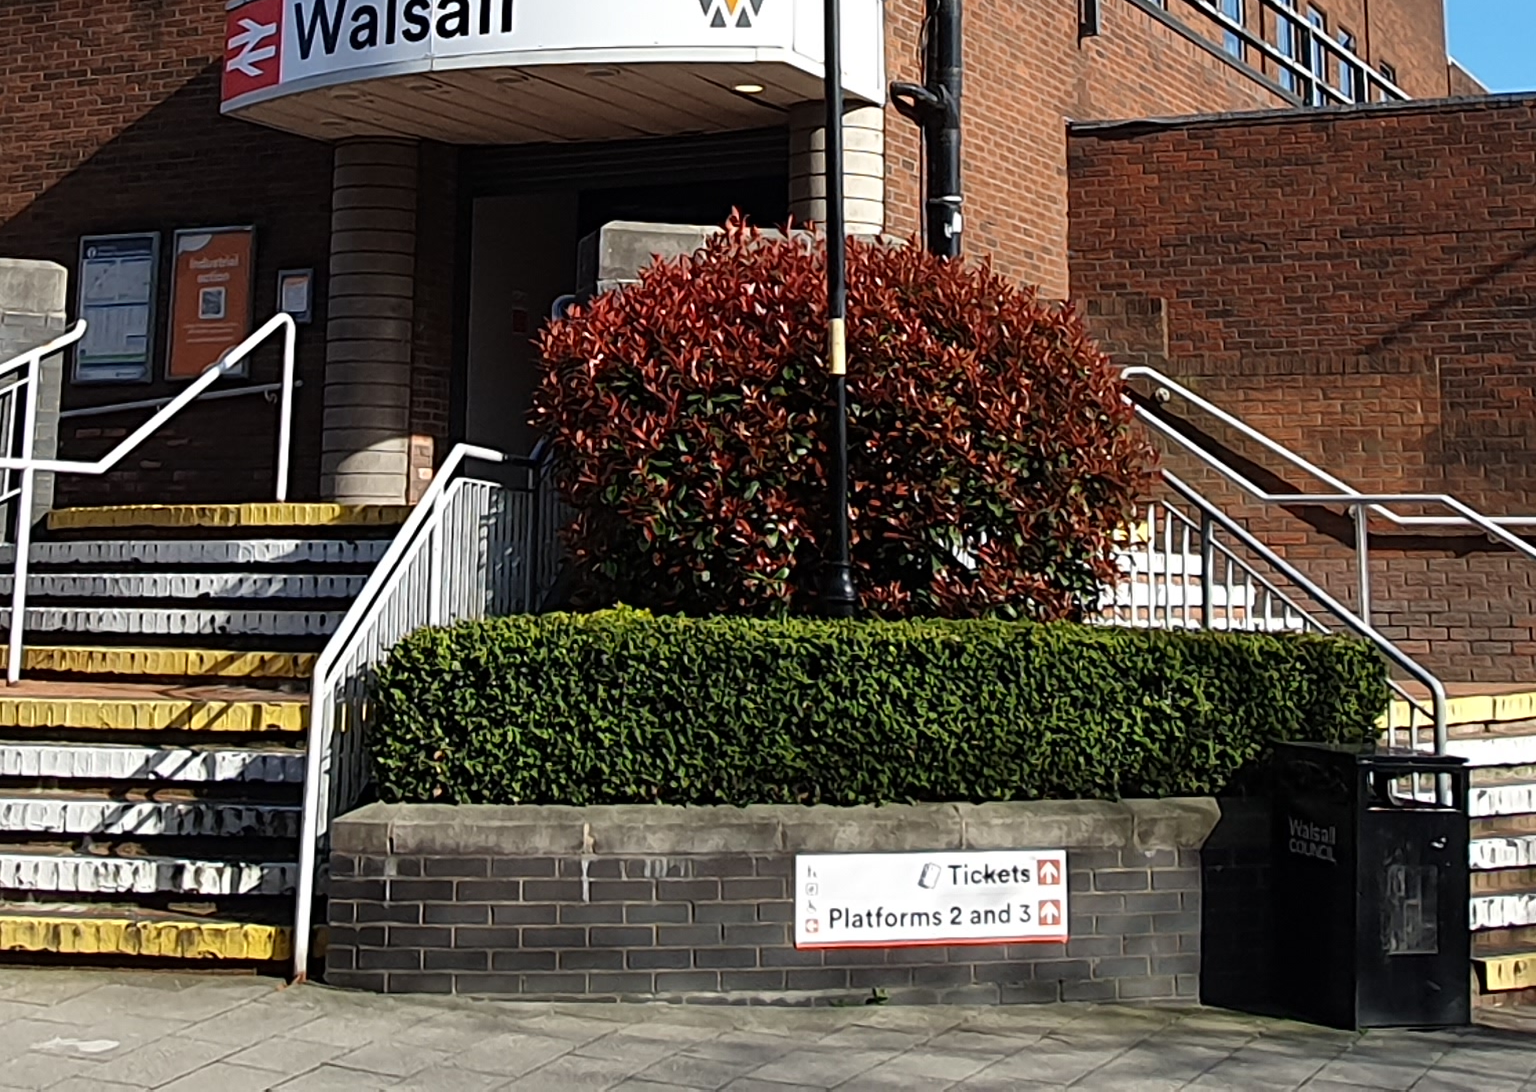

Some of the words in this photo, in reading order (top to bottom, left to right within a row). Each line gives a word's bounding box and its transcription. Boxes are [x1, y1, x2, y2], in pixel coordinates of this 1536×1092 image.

[1288, 814, 1336, 845] Walsall
[1289, 838, 1337, 864] COUNCIL
[948, 864, 1031, 886] Tickets
[829, 907, 942, 929] Platforms
[950, 906, 962, 926] 2
[970, 903, 1011, 925] and
[1019, 905, 1032, 923] 3
